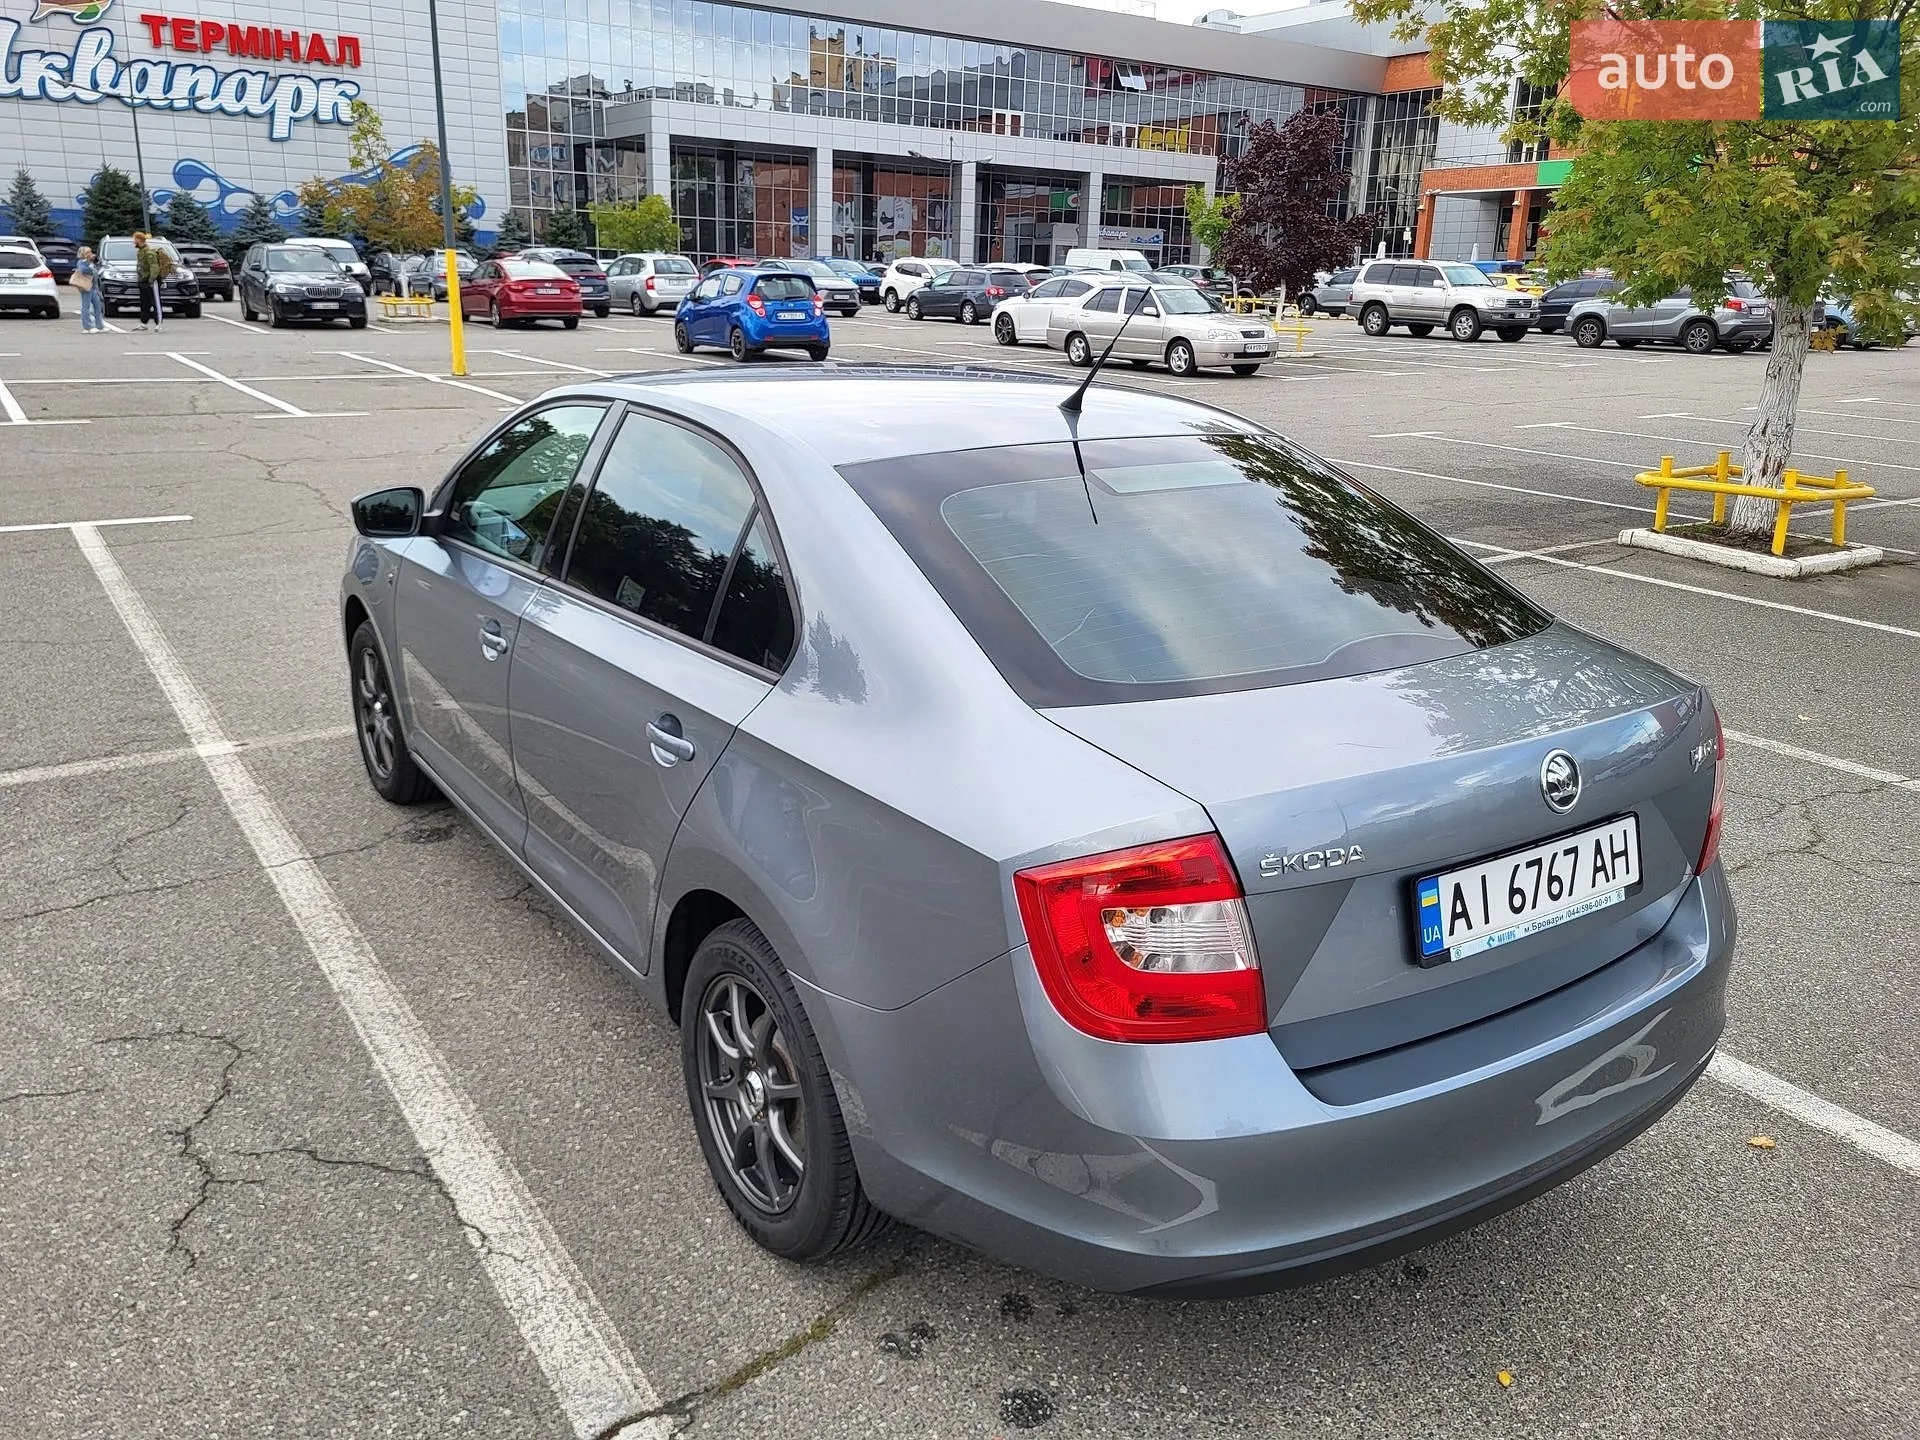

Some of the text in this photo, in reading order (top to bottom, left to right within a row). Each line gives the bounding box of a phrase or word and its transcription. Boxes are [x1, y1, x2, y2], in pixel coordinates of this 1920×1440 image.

[140, 13, 362, 68] ТЕРМІНАЛ
[1260, 844, 1365, 878] ŠKODA
[1423, 829, 1630, 944] UA AI 6767 AH
